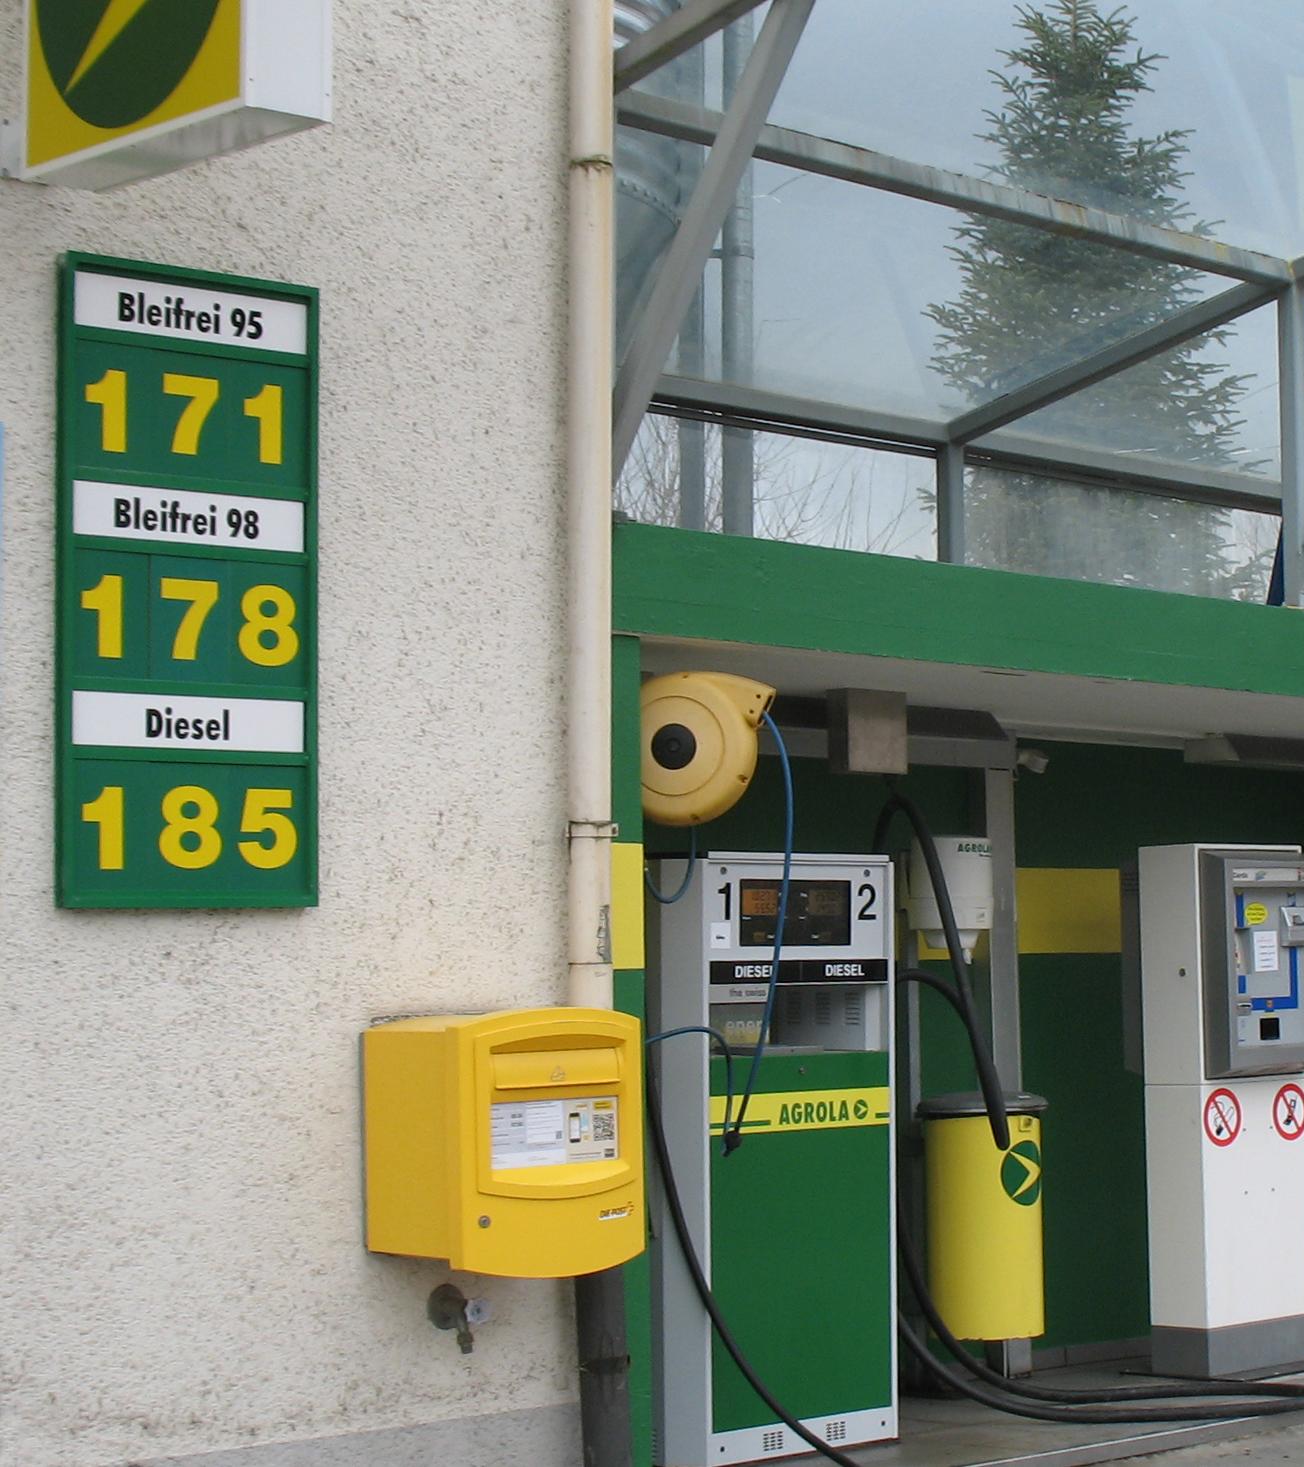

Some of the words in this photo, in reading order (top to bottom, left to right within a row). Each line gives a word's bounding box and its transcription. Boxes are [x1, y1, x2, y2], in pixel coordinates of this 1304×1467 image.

[118, 292, 220, 334] Bleifrei
[230, 309, 264, 340] 95
[113, 498, 218, 537] Bleifrei
[226, 508, 260, 540] 98
[145, 708, 231, 741] Diesel
[718, 883, 732, 920] 1
[857, 883, 877, 920] 2
[735, 965, 774, 978] DIESE
[825, 964, 865, 977] DIESEL
[726, 1019, 763, 1032] ener
[779, 1100, 850, 1125] AGROLA
